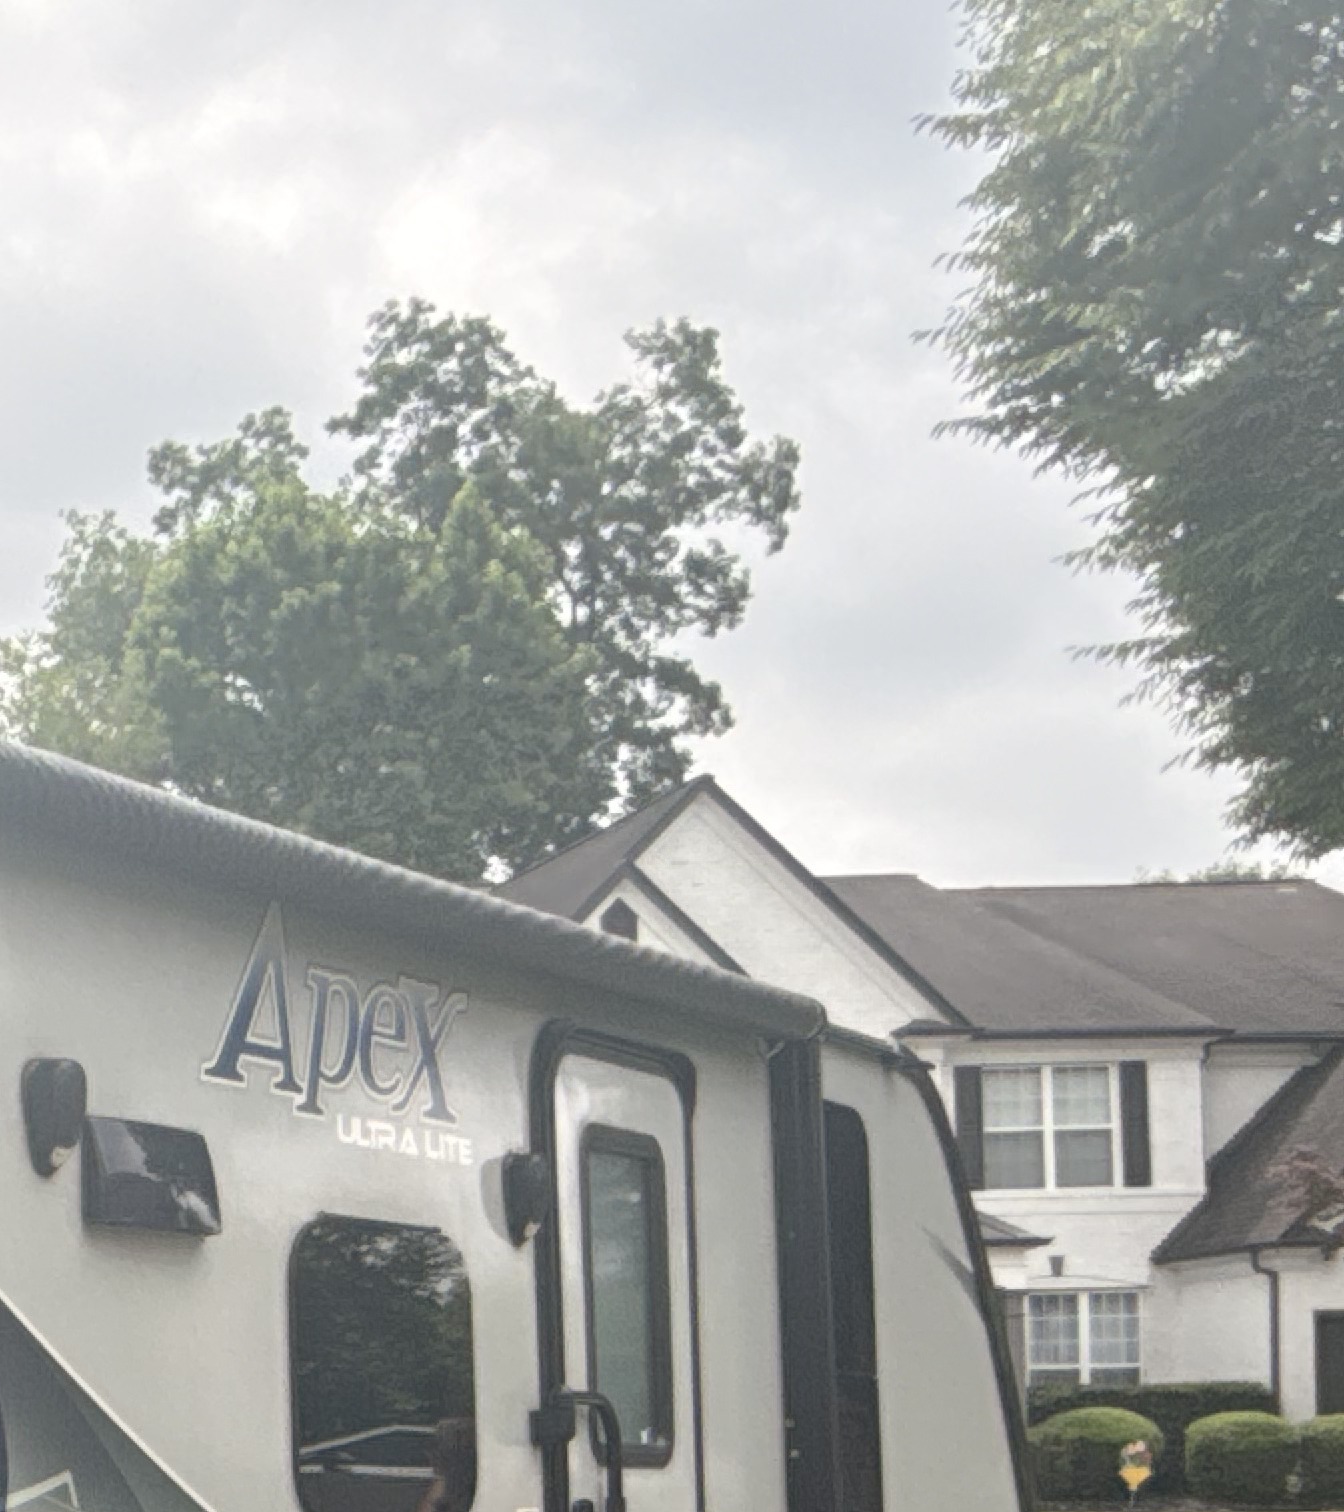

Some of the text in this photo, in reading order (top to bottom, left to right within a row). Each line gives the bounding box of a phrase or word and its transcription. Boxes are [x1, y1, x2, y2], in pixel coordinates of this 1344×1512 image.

[201, 901, 468, 1124] Apex
[336, 1113, 474, 1166] ULTRA LITE
